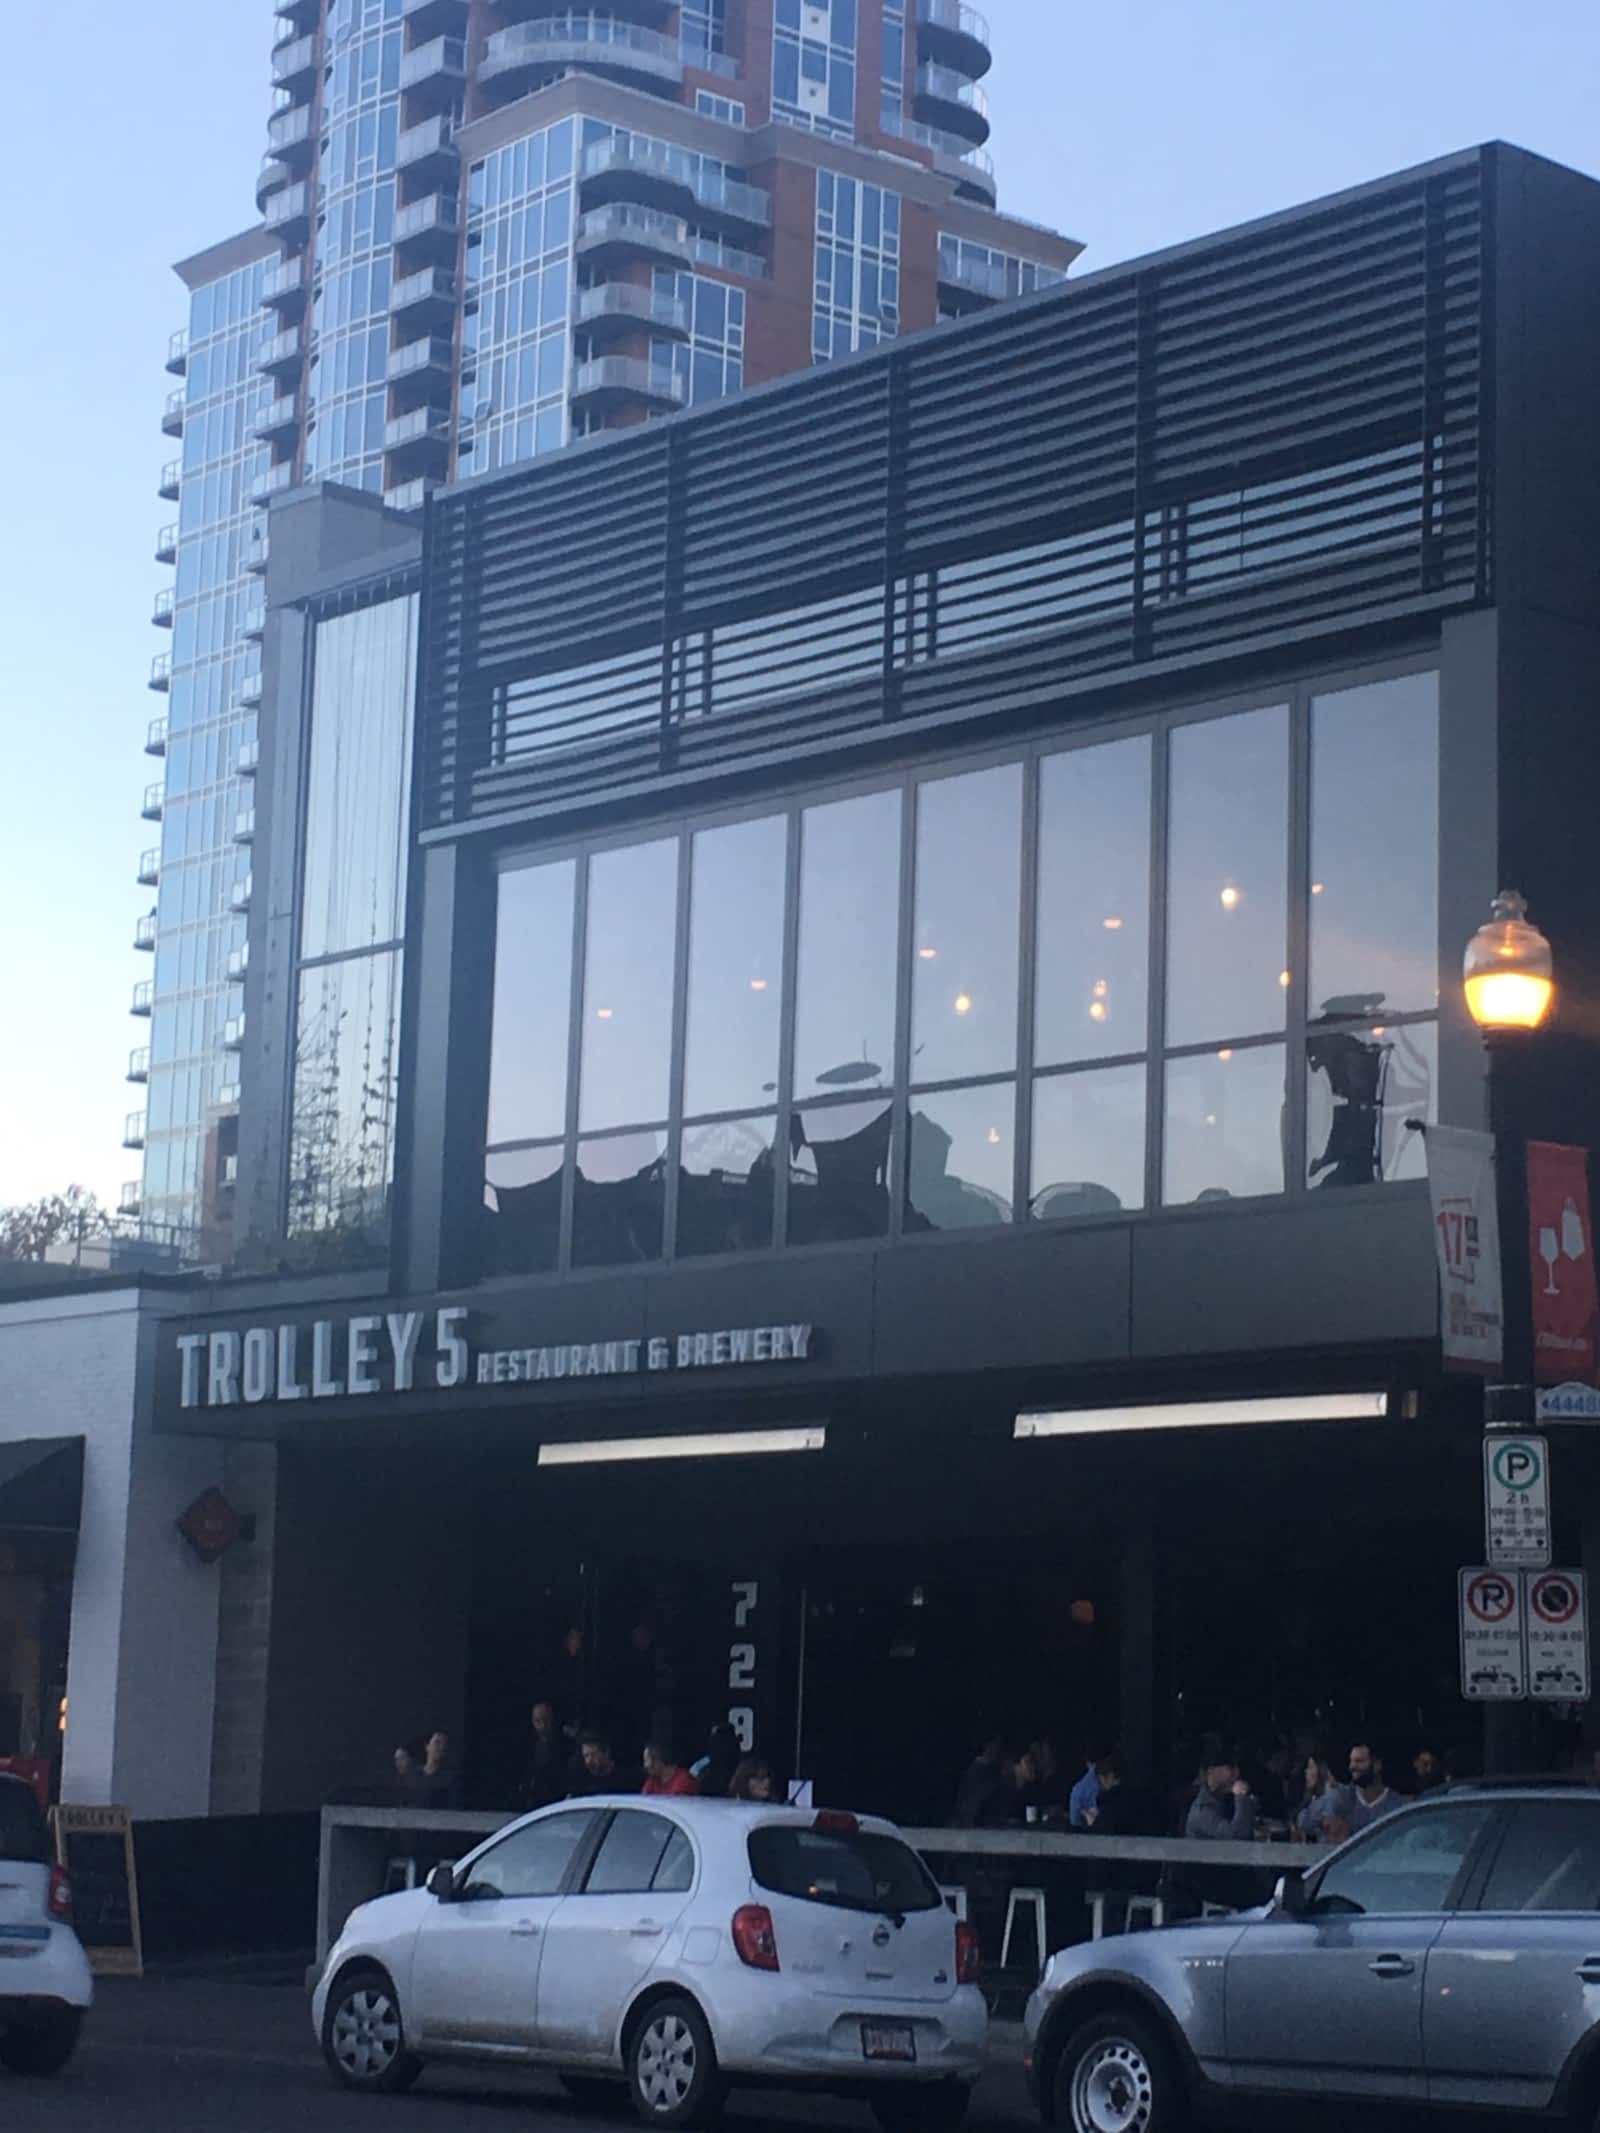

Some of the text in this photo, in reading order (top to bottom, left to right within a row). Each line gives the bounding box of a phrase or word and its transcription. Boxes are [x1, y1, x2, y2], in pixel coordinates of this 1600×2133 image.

[176, 1306, 813, 1408] TROLLEY 5 RESTAURANT & BREWERY
[1506, 1451, 1530, 1481] P
